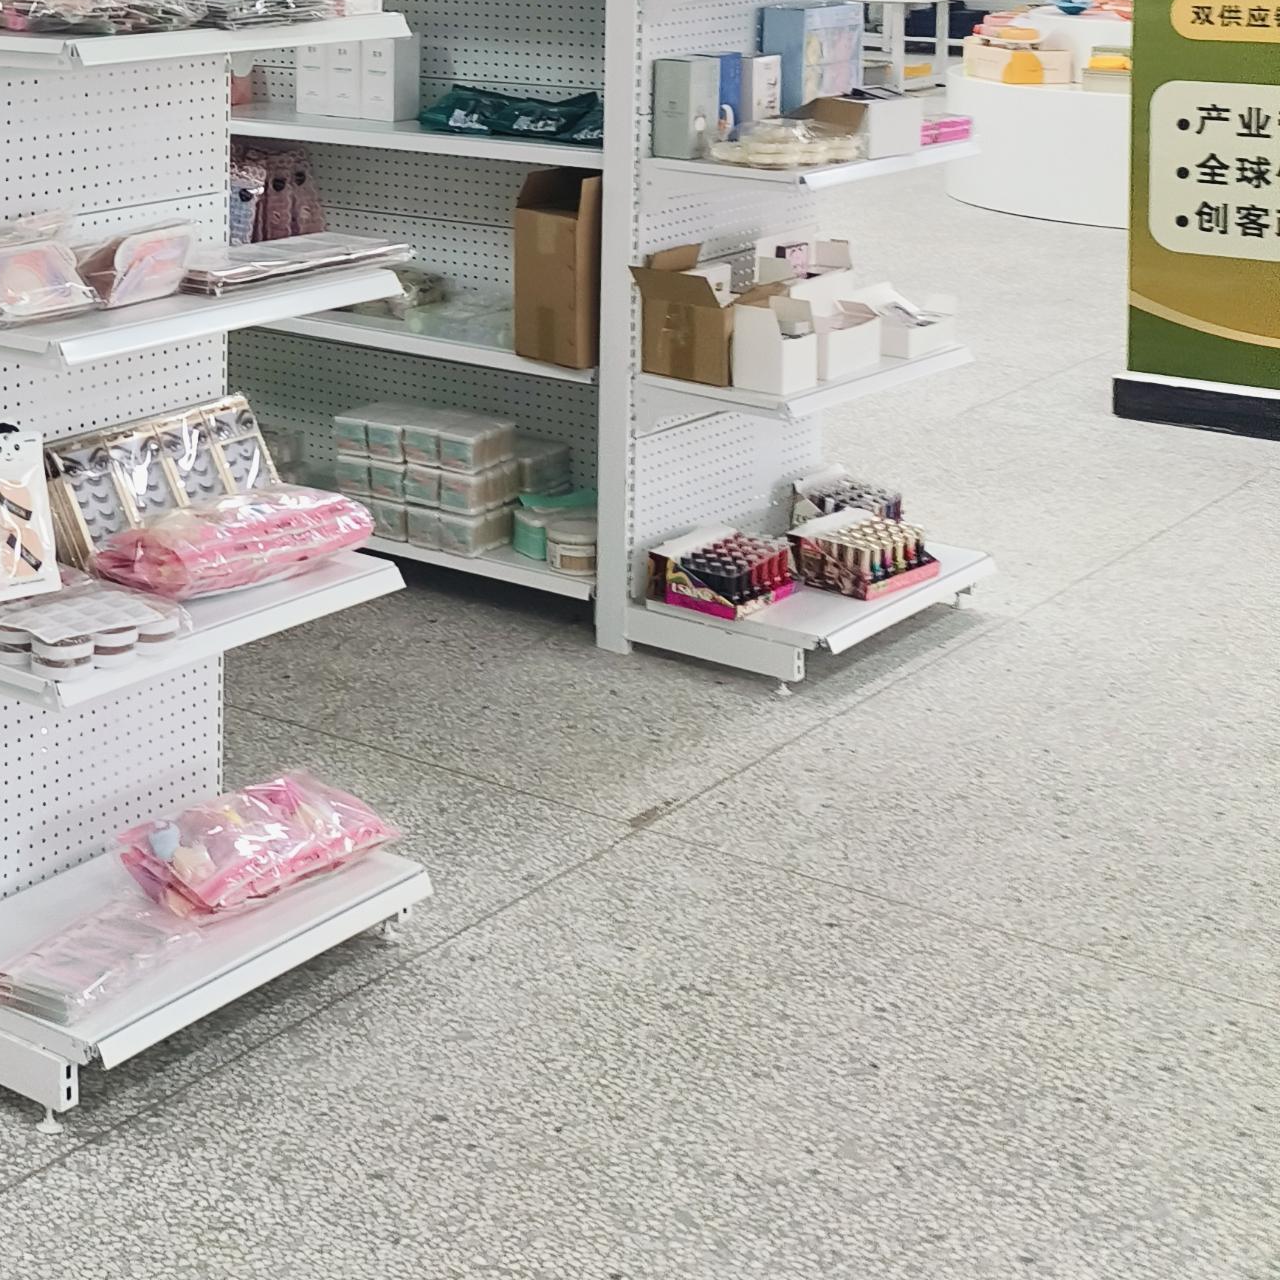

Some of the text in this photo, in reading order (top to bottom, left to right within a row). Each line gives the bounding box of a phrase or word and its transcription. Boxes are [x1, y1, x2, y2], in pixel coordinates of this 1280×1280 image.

[1190, 4, 1280, 28] 双供应
[1195, 103, 1280, 139] 产业
[1195, 152, 1280, 188] 全球
[1195, 200, 1280, 239] 创客
